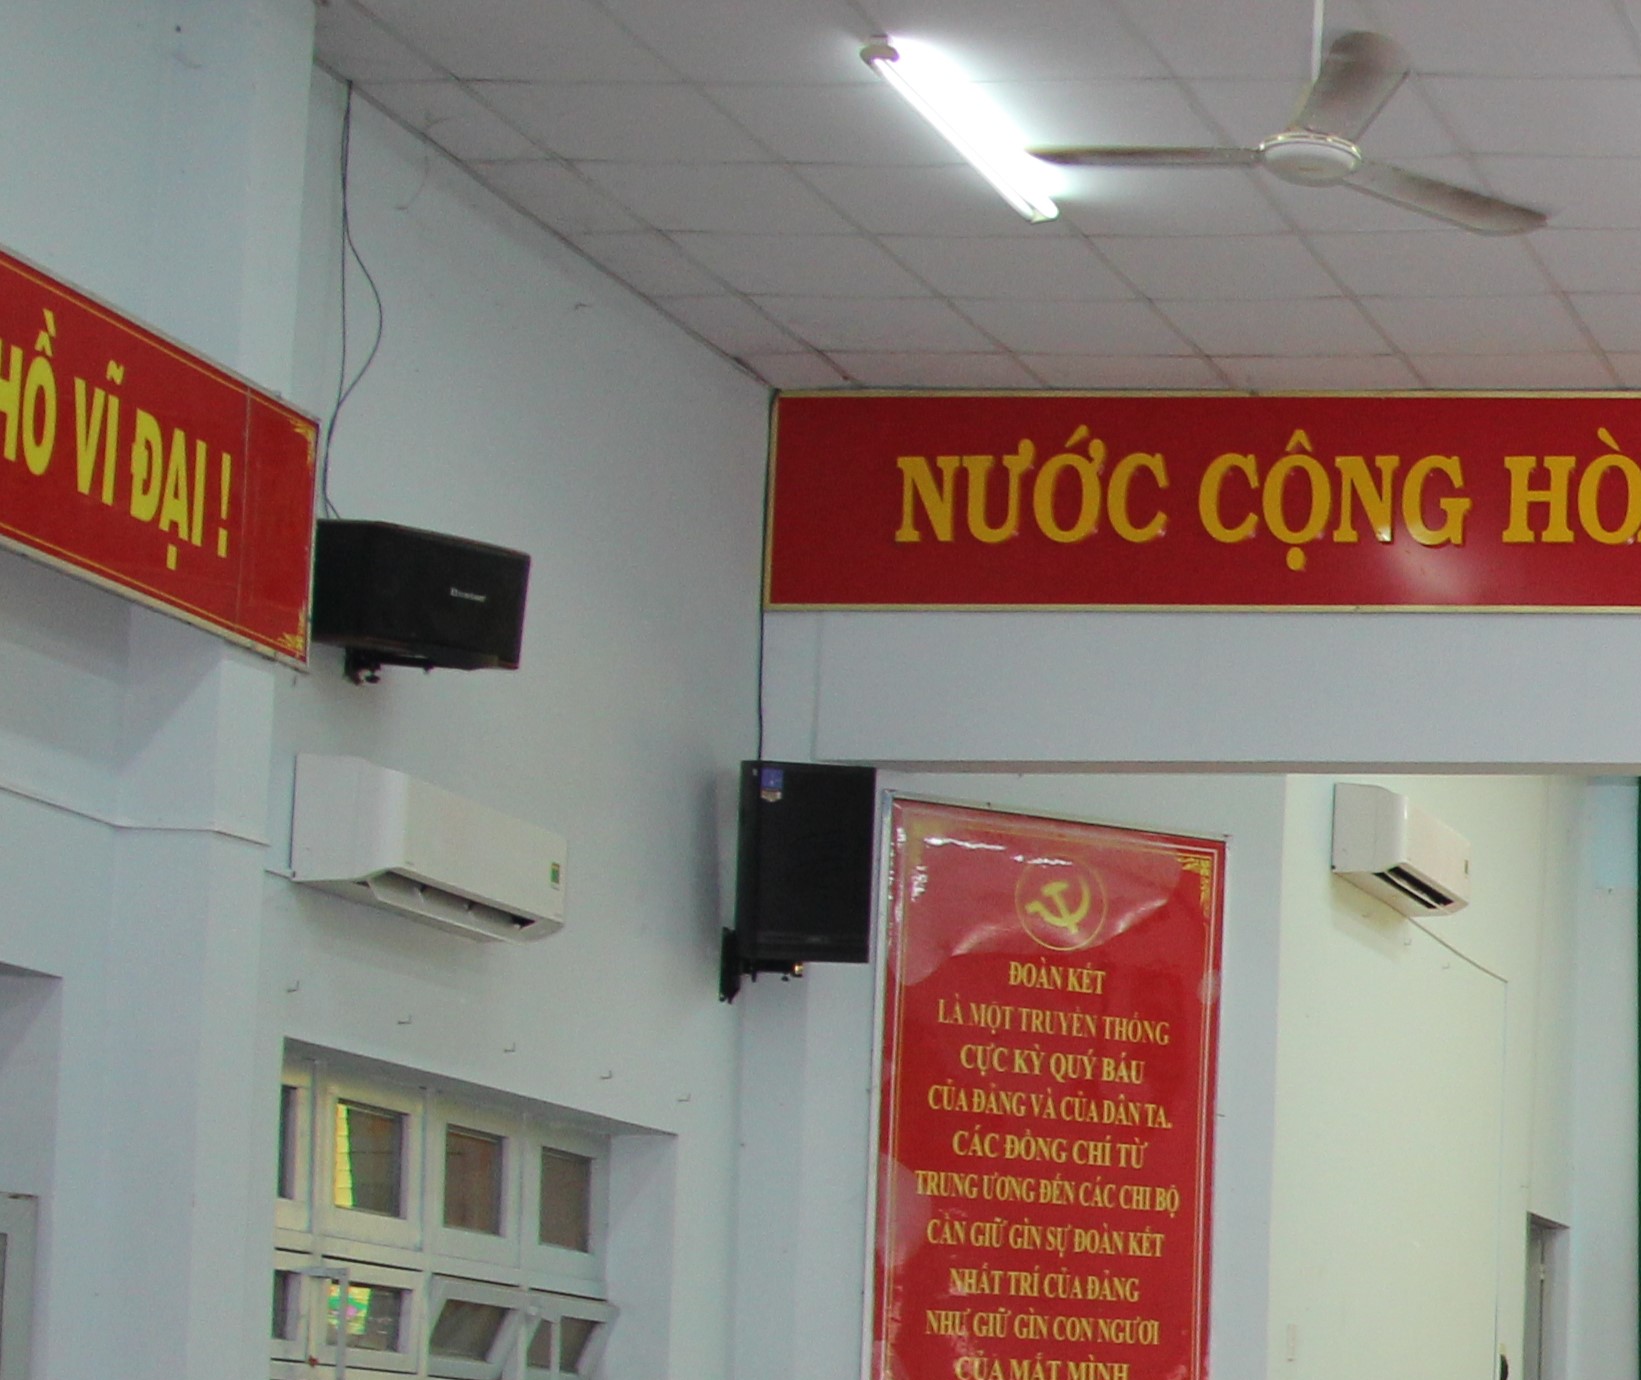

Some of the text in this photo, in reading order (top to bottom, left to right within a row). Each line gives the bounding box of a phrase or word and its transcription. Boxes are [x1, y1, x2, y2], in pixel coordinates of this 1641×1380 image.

[74, 360, 124, 507] VĨ
[130, 407, 207, 570] ĐẠI
[895, 424, 1169, 544] NƯỚC
[1199, 429, 1472, 572] CỘNG
[1009, 957, 1063, 990] ĐOÀN
[938, 994, 963, 1025] LÀ
[969, 1001, 1014, 1034] MỘT
[960, 1043, 1145, 1084] CỰC KỲ QUÝ BÁU
[928, 1078, 968, 1112] CỦA
[973, 1083, 1026, 1117] ĐẢNG
[1031, 1088, 1056, 1119] VÀ
[1060, 1091, 1098, 1123] CỦA
[1103, 1094, 1141, 1126] DÂN
[952, 1125, 999, 1158] CÁC
[1072, 1135, 1111, 1166] CHÍ
[1117, 1137, 1148, 1169] TỪ
[915, 1170, 1179, 1218] TRUNG ƯƠNG ĐẾN CÁC CHI BỘ
[970, 1217, 1008, 1248] GIỮ
[1009, 1218, 1043, 1250] GÌN
[1046, 1224, 1072, 1258] SỰ
[1074, 1223, 1124, 1255] ĐOÀN
[1129, 1226, 1165, 1257] KẾT
[950, 1263, 1139, 1302] NHẤT TRÍ CỦA ĐẢNG
[926, 1308, 970, 1336] NHƯ
[973, 1307, 1011, 1338] GIỮ
[1014, 1308, 1050, 1340] GÌN
[1053, 1316, 1093, 1342] CON
